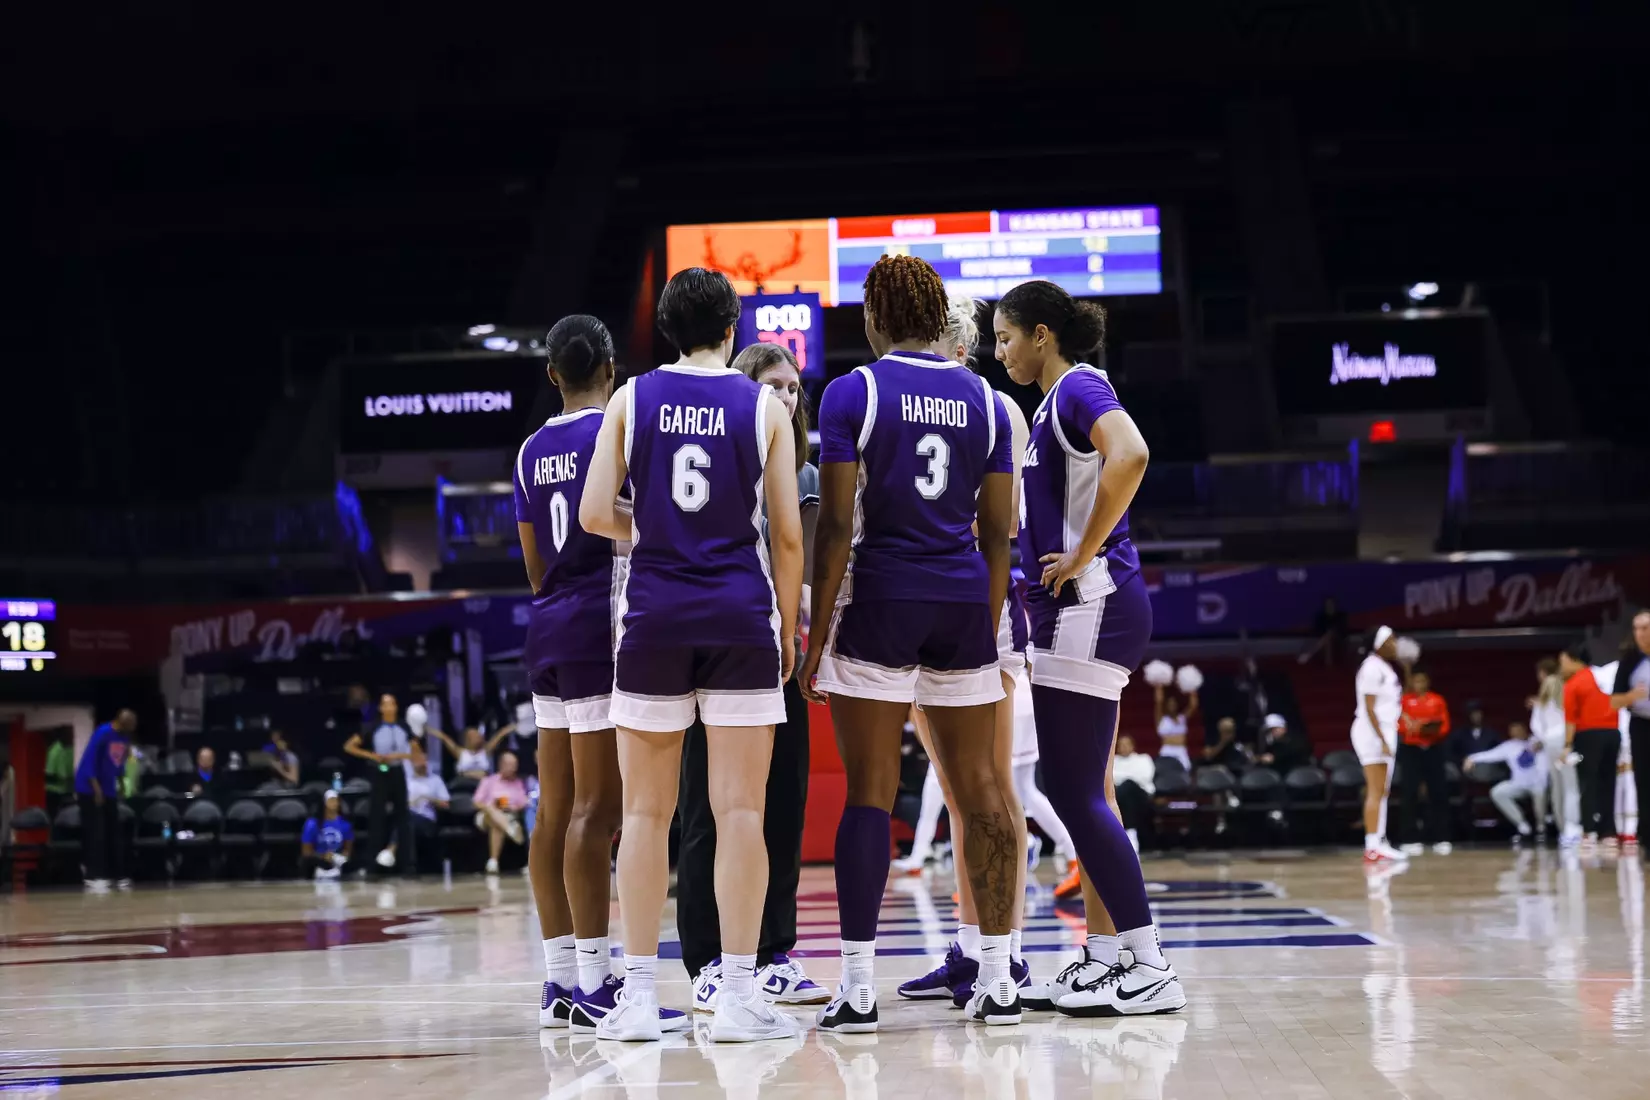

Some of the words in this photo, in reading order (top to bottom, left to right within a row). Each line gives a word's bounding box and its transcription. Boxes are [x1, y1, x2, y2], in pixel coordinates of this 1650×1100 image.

[364, 394, 424, 417] LOUIS
[426, 390, 513, 414] VUITTON
[659, 403, 726, 436] GARCIA
[901, 393, 968, 428] HARROD
[533, 451, 578, 487] ARENAS
[671, 443, 711, 513] 6
[914, 432, 951, 501] 3
[549, 490, 569, 554] 0
[1464, 567, 1496, 607] UP
[1494, 560, 1626, 623] Dallas
[2, 621, 46, 651] 18
